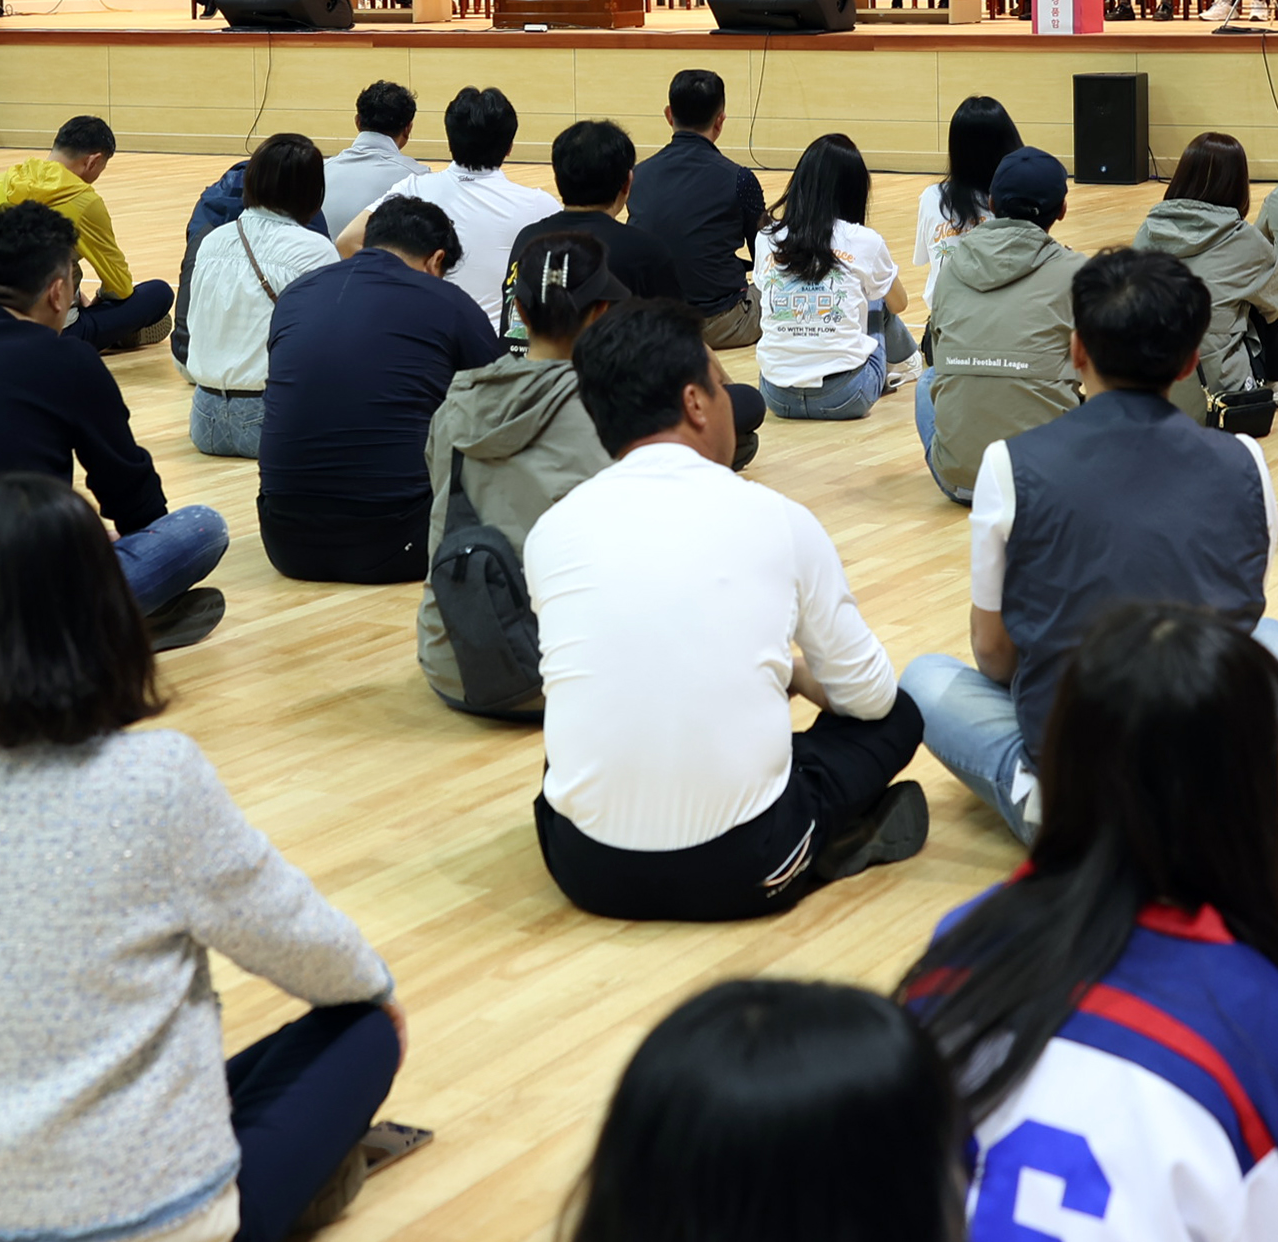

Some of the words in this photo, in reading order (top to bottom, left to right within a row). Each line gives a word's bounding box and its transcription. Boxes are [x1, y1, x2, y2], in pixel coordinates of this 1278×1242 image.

[945, 356, 971, 366] National
[972, 357, 1002, 367] Football
[1003, 359, 1029, 370] League
